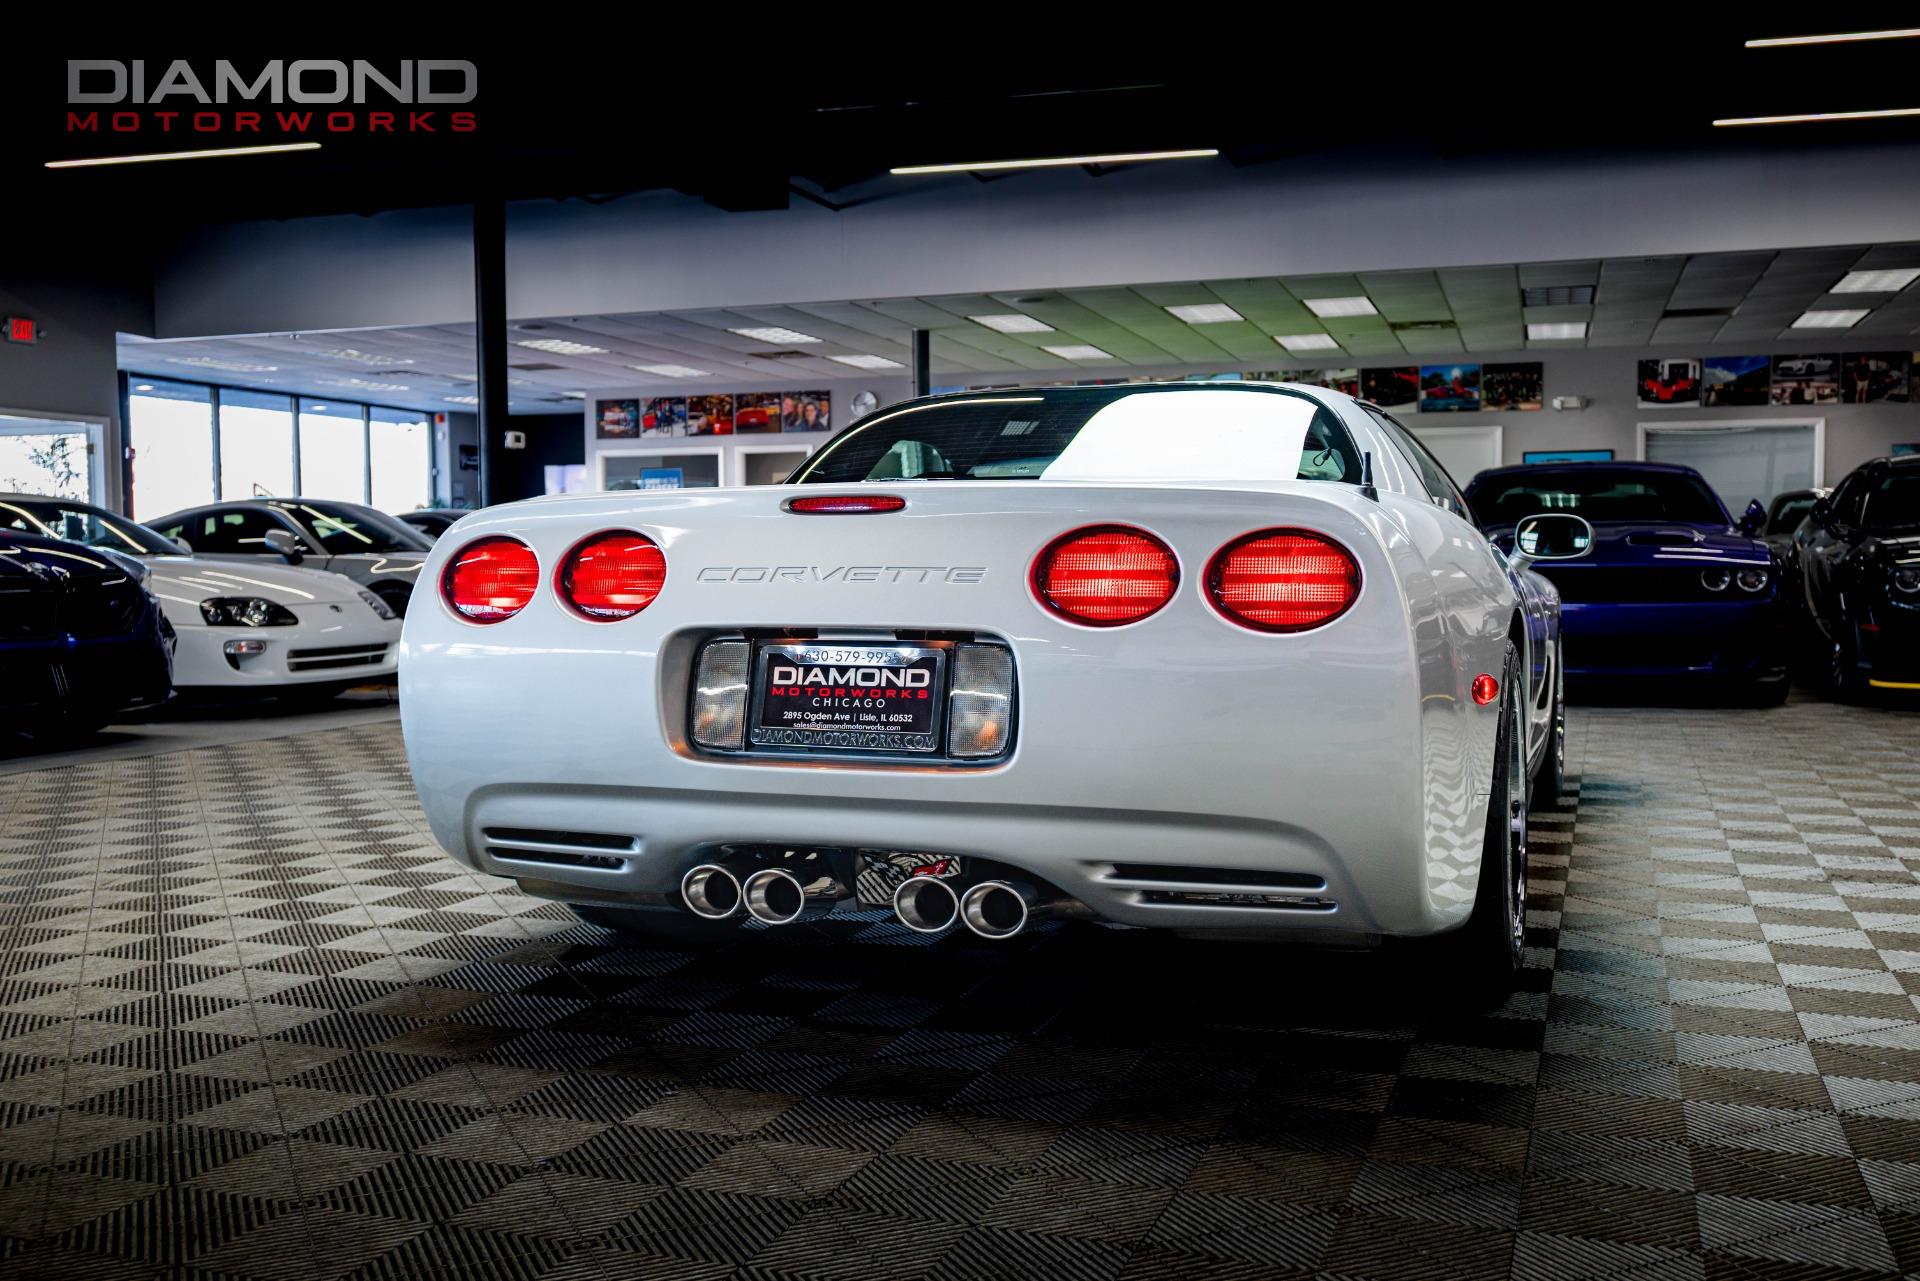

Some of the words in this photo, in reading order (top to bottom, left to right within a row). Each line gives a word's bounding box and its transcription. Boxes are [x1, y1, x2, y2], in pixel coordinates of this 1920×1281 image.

[696, 566, 988, 584] CORVETTE
[772, 666, 931, 688] DIAMOND
[771, 687, 929, 699] MOTORWORKS
[812, 698, 886, 708] CHICAGO
[783, 711, 802, 720] 2895
[804, 712, 832, 722] Ogden
[833, 713, 850, 721] Ave
[859, 713, 879, 723] Lisle,
[880, 714, 888, 722] IL
[889, 714, 913, 723] 60532
[793, 722, 901, 731] sales@diamondmotorworks.com
[751, 729, 935, 748] DIAMONDMOTORWORKS.COM
